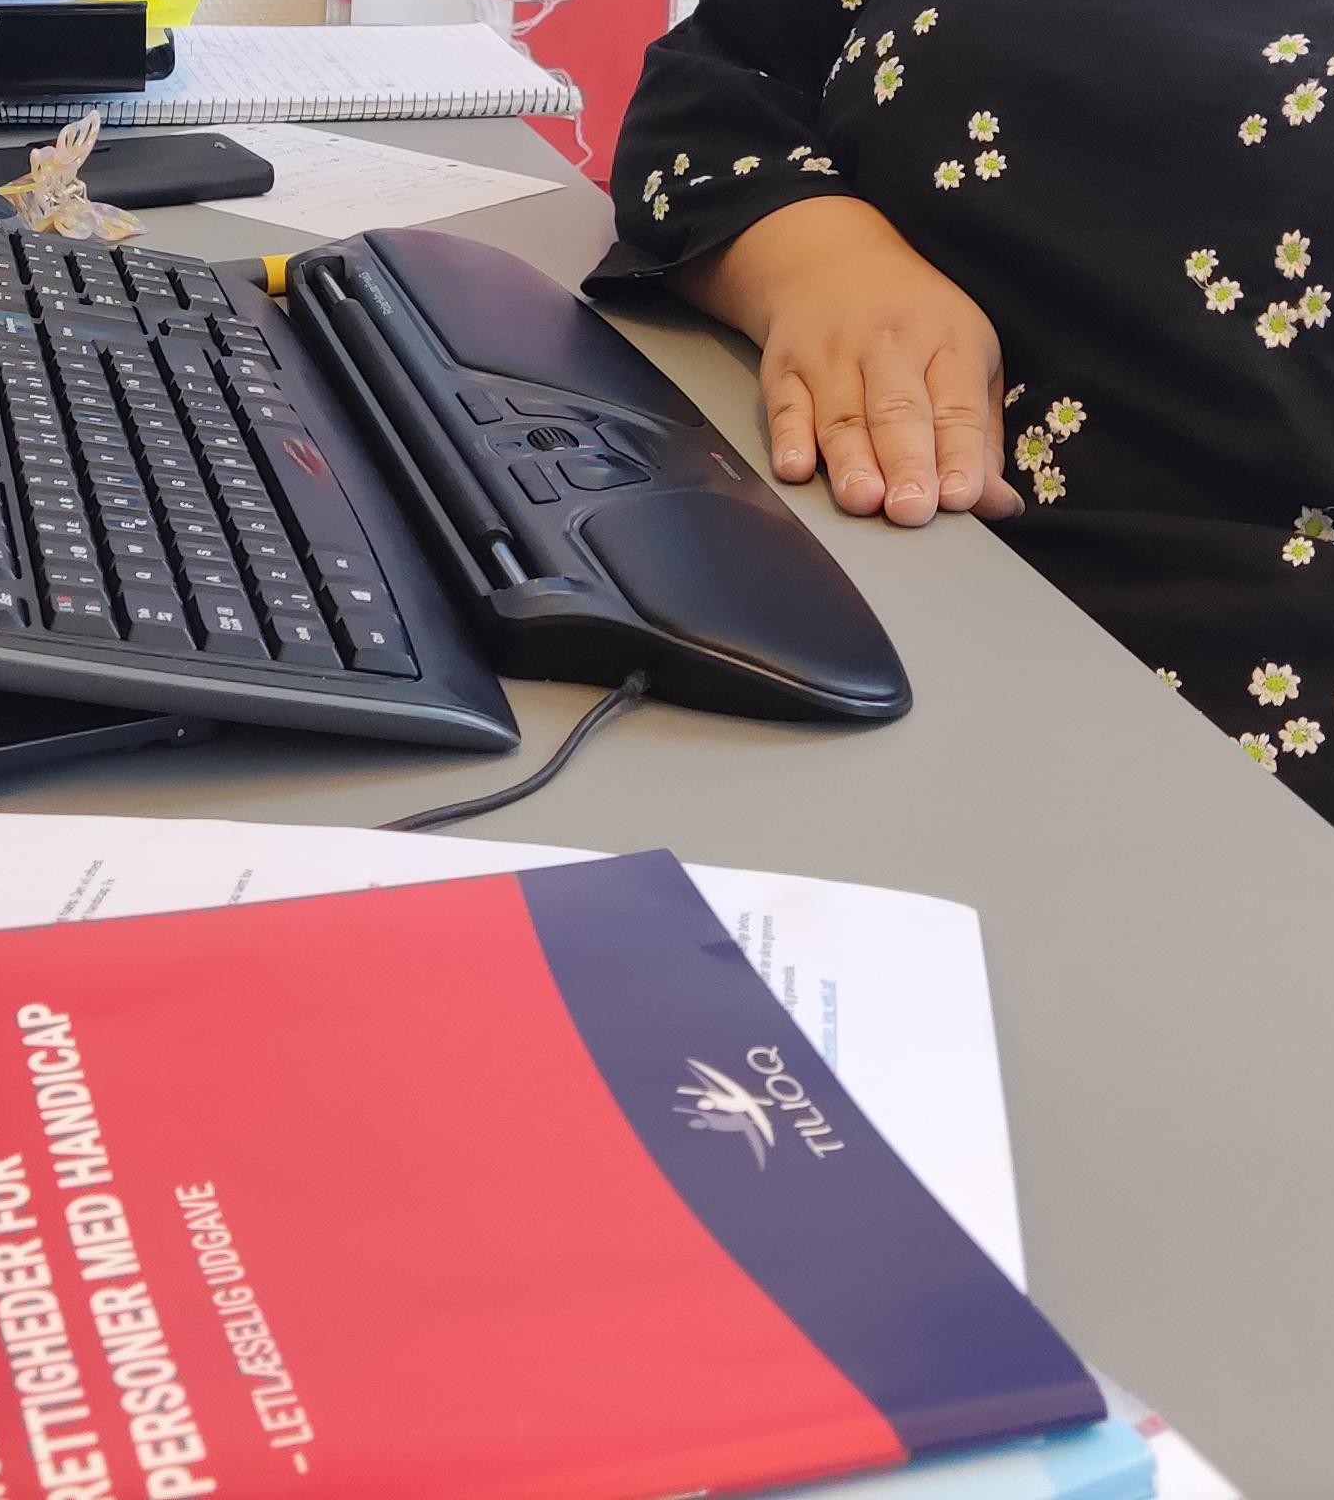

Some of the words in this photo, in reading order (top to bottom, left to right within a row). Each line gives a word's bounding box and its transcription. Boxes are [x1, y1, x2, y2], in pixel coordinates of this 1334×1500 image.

[271, 571, 287, 580] Z
[16, 1003, 114, 1190] HANDICAP
[745, 1044, 846, 1159] TILIOQ
[65, 1193, 141, 1282] MED
[175, 1180, 245, 1287] UDGAVE
[89, 1281, 218, 1500] PERSONER
[212, 1284, 314, 1448] LETLÆSELIG
